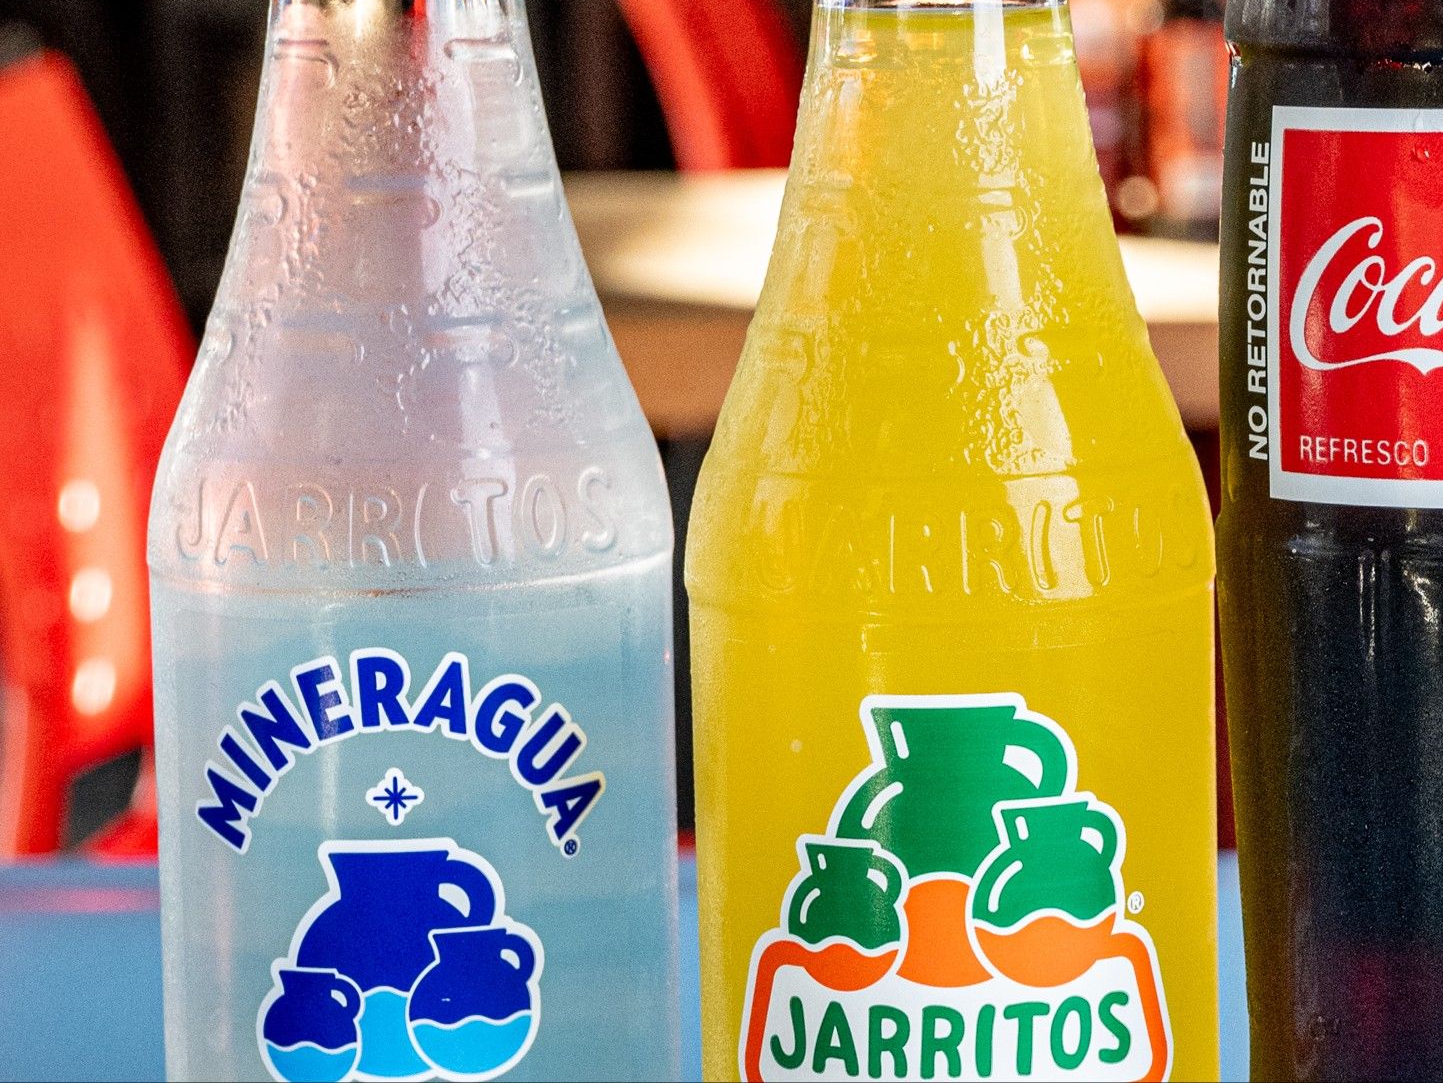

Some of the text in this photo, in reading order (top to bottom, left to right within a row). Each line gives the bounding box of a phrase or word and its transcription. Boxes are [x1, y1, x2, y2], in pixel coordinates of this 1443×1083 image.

[1248, 141, 1270, 460] NO RETORNABLE
[1300, 436, 1429, 467] REFRESCO
[176, 465, 616, 569] JARRITOS
[197, 652, 604, 851] MINERAGUA
[769, 989, 1132, 1080] JARRITOS
